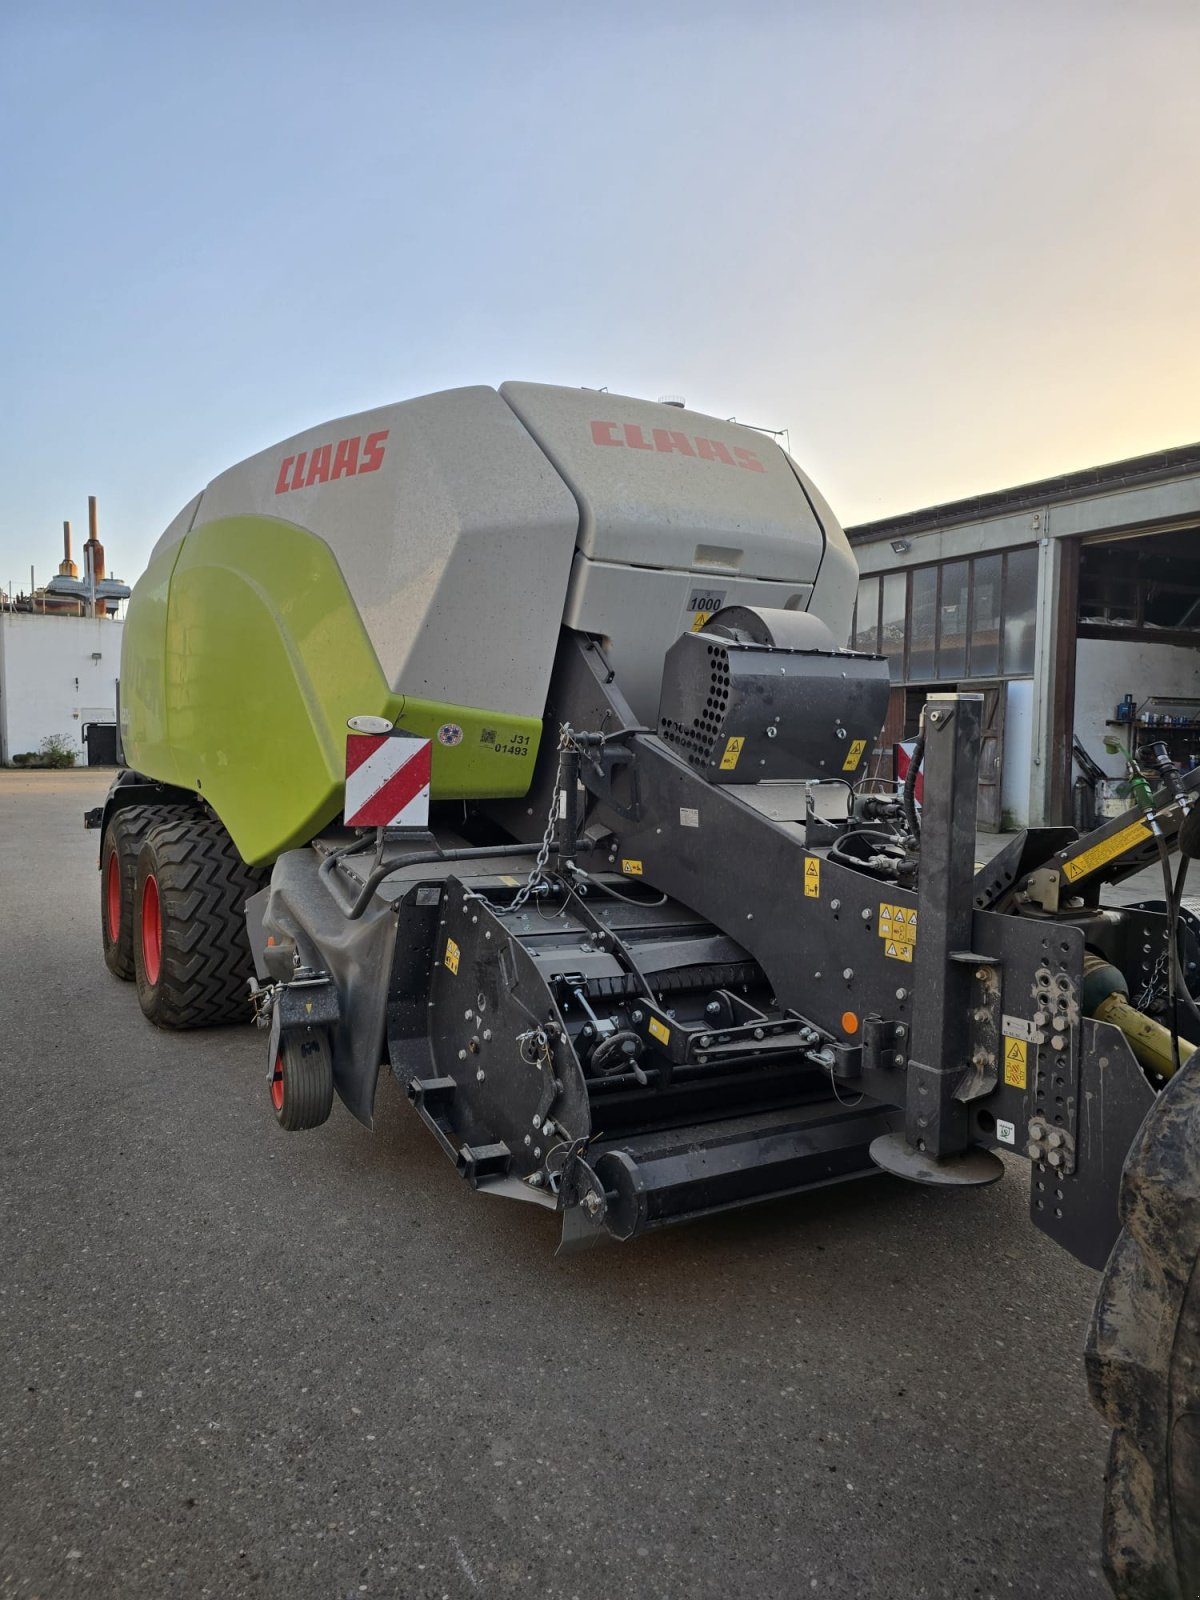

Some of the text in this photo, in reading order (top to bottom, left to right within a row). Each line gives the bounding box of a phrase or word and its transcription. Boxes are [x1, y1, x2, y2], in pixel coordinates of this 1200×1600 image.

[590, 421, 764, 473] CLAAS
[275, 430, 389, 494] CLAAS
[691, 597, 721, 611] 1000
[510, 734, 530, 745] J31
[494, 743, 528, 757] 01493
